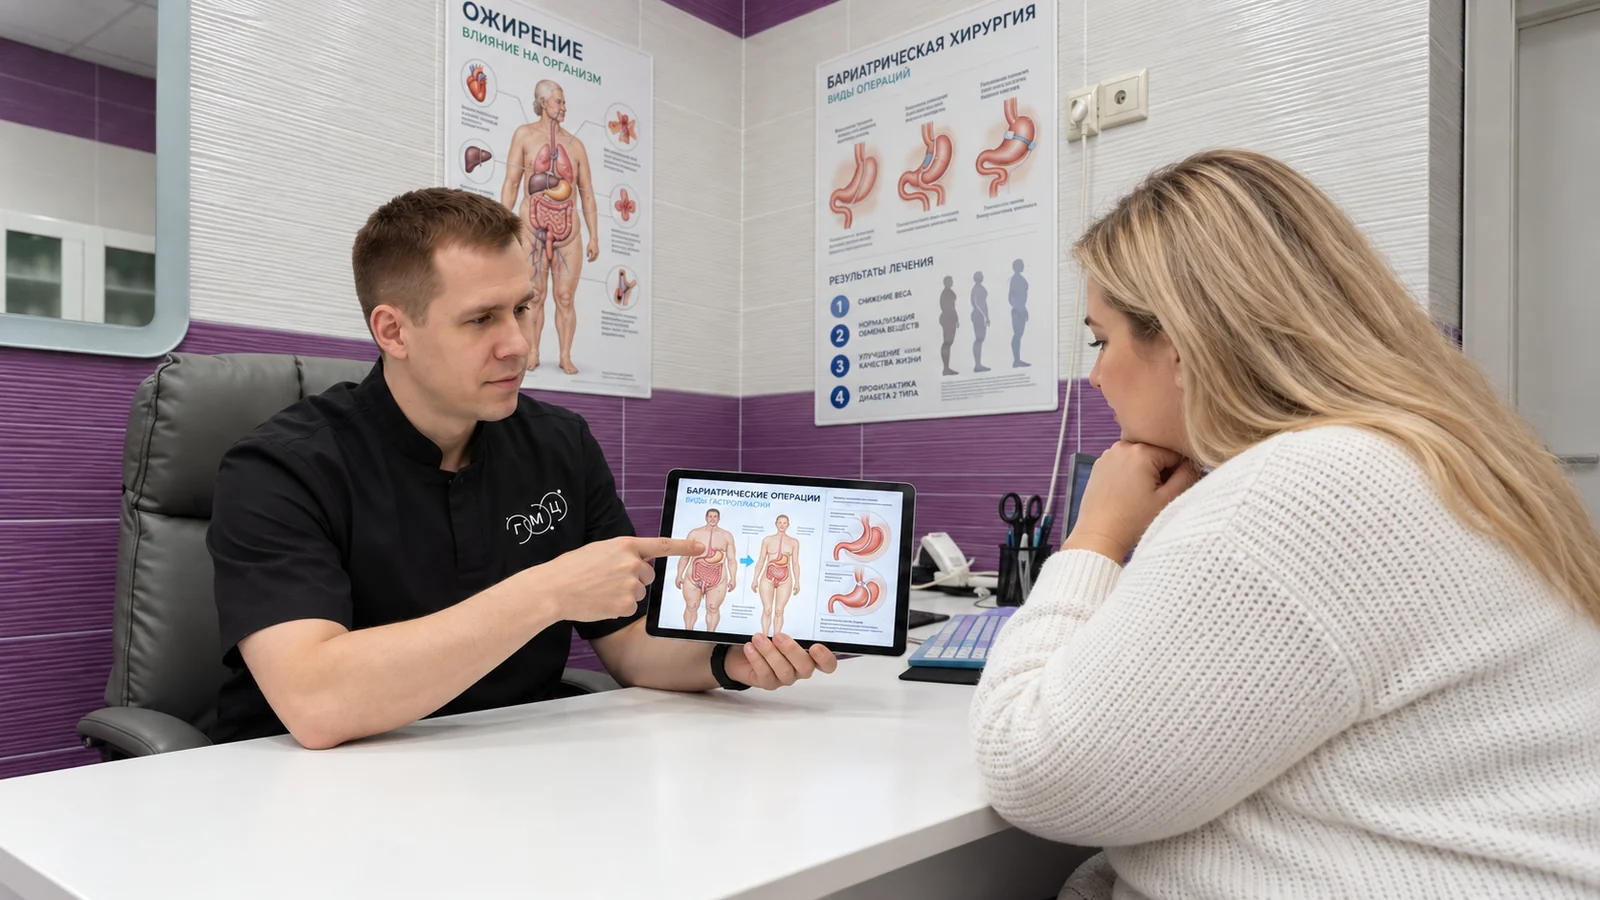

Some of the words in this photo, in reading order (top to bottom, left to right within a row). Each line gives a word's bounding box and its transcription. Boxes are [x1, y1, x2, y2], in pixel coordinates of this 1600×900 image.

[462, 1, 583, 61] ОЖИРЕНИЕ
[827, 36, 945, 89] БАРИАТРИЧЕСКАЯ
[950, 4, 1036, 47] ХИРУРГИЯ
[462, 27, 519, 56] ВЛИЯНИЕ
[523, 48, 540, 63] НА
[543, 56, 601, 86] ОРГАНИЗМ
[827, 87, 854, 104] ВИДЫ
[856, 67, 911, 95] ОПЕРАЦИЙ
[829, 266, 886, 286] РЕЗУЛЬТАТЫ
[889, 256, 934, 274] ЛЕЧЕНИЯ
[858, 292, 893, 305] СНИЖЕНИЕ
[894, 289, 912, 299] ВЕСА
[836, 300, 843, 313] 1
[858, 313, 915, 329] НОРМАЛИЗАЦИЯ
[858, 327, 886, 337] ОБМЕНА
[887, 321, 920, 333] ВЕЩЕСТВ
[836, 329, 844, 342] 2
[836, 360, 844, 373] 3
[858, 358, 894, 370] КАЧЕСТВА
[858, 380, 917, 393] ПРОФИЛАКТИКА
[835, 390, 844, 404] 4
[858, 391, 891, 403] ДИАБЕТА
[892, 391, 898, 399] 2
[899, 389, 919, 398] ТИПА
[686, 486, 768, 499] БАРИАТРИЧЕСКИЕ
[770, 491, 821, 503] ОПЕРАЦИИ
